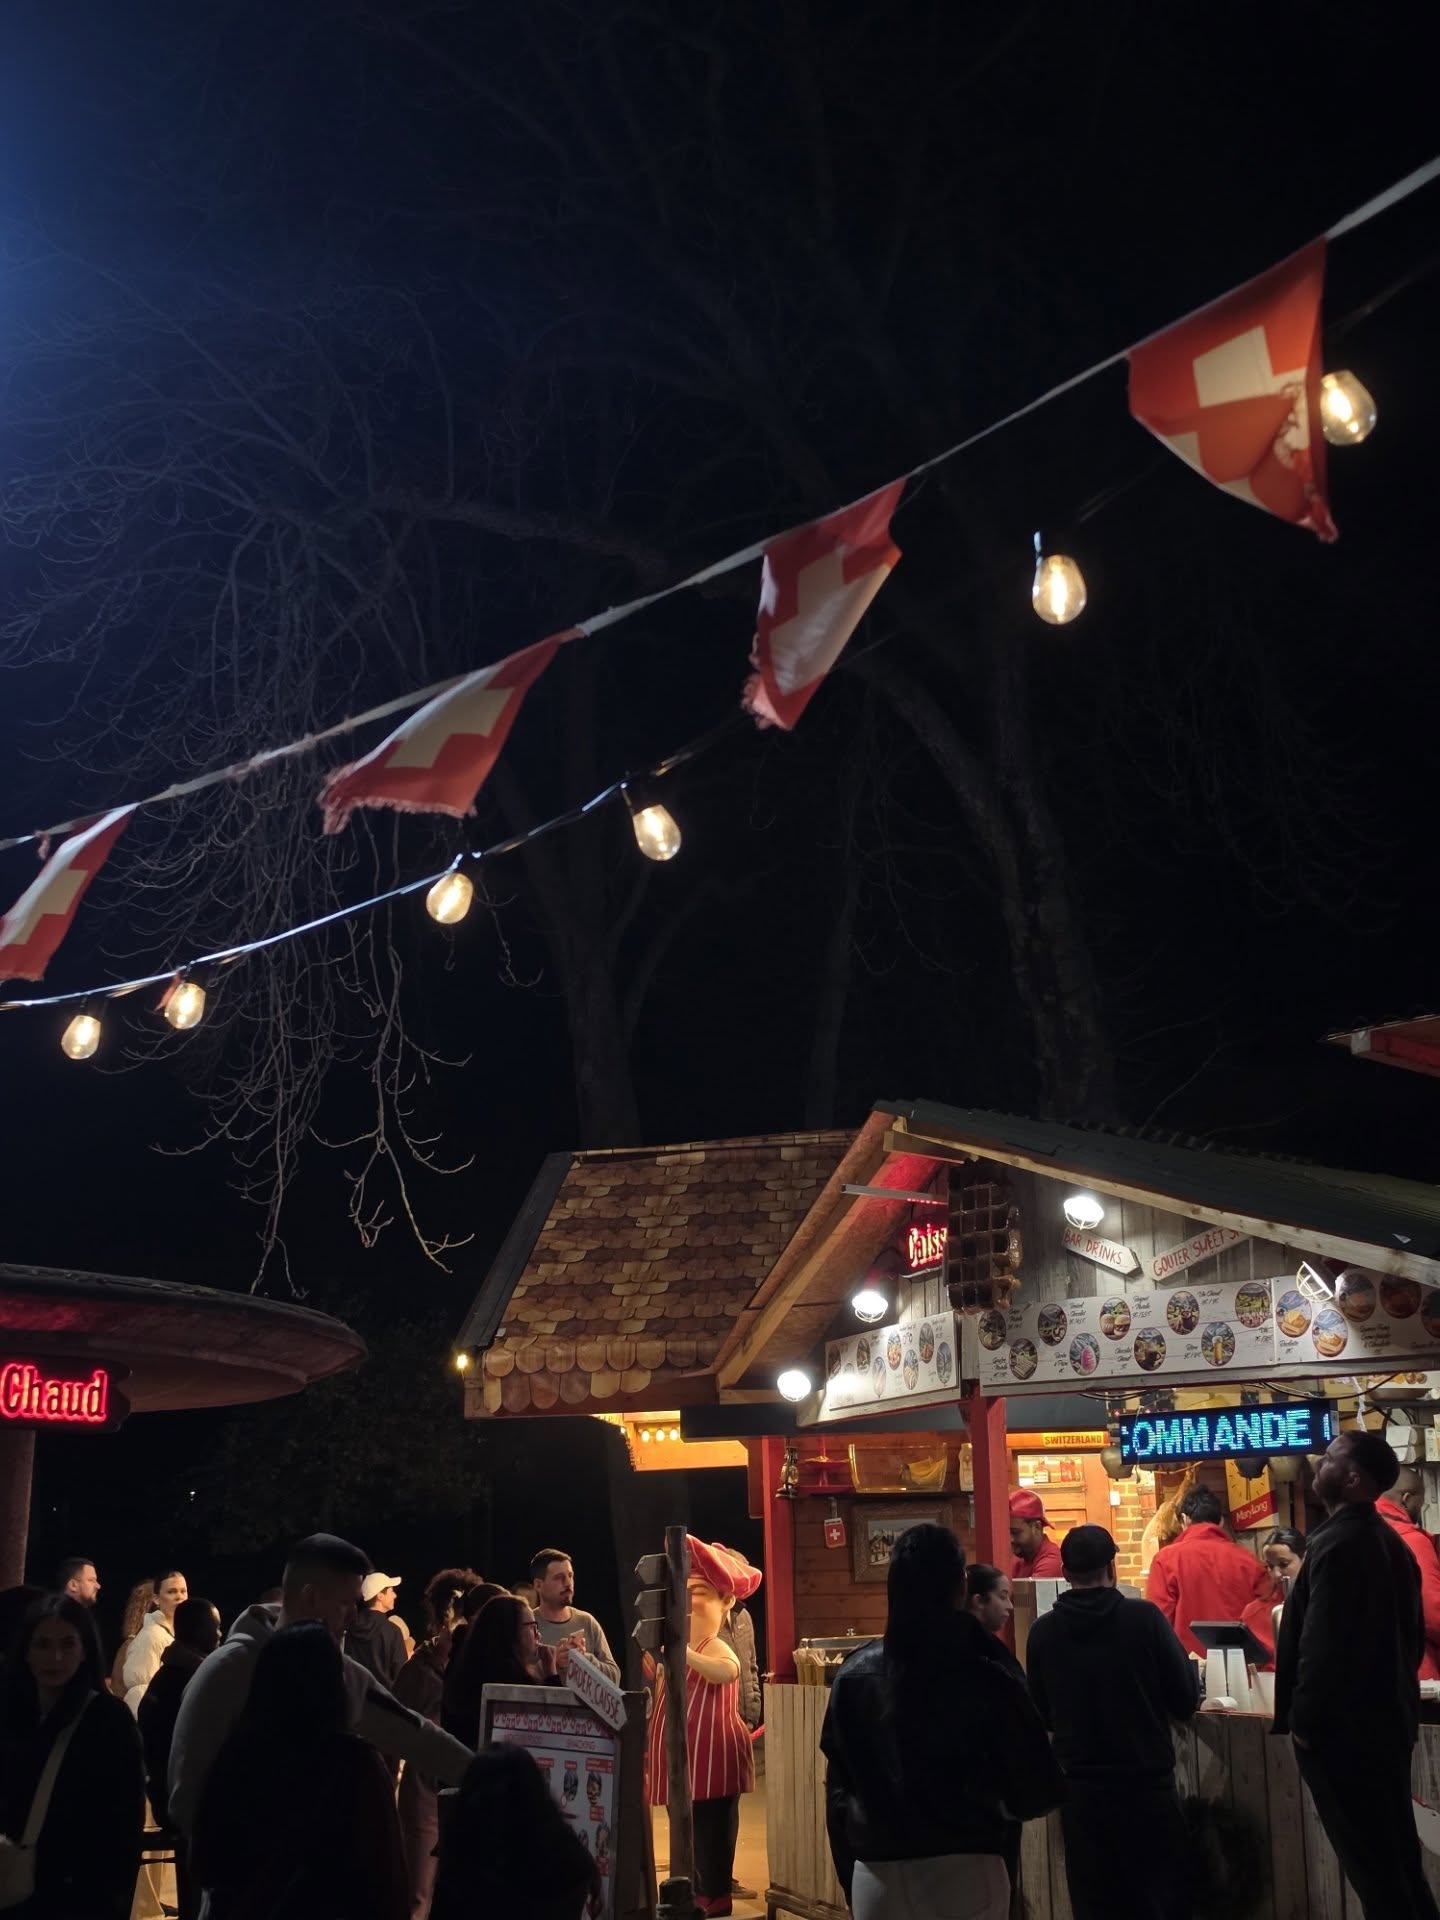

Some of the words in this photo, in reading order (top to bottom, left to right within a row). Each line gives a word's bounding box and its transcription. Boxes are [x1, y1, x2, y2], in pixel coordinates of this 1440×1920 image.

[1063, 1227, 1082, 1247] BAR
[1086, 1239, 1122, 1265] DRINKS
[1153, 1248, 1191, 1277] GOUTER
[1193, 1228, 1225, 1258] SWEET
[0, 1363, 108, 1422] Chaud
[1044, 1434, 1102, 1445] SWITZERLAND
[567, 1658, 593, 1694] ORDER
[594, 1681, 621, 1724] CAISSE
